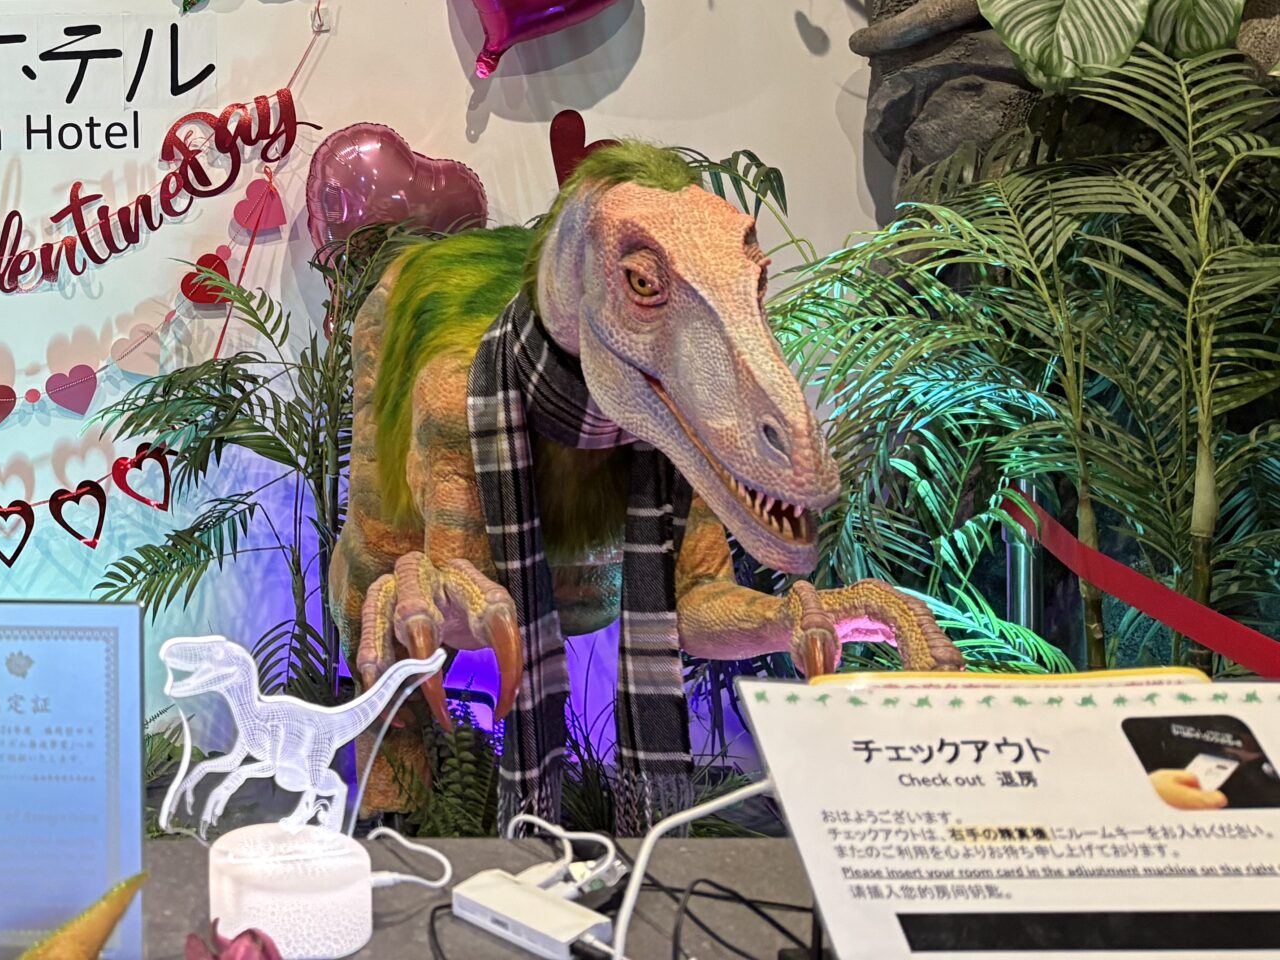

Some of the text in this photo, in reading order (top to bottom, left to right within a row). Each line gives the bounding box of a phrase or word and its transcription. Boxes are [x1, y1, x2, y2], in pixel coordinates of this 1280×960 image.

[25, 110, 140, 150] Hotel
[161, 88, 322, 198] Day
[852, 737, 1051, 764] チェックアウト
[898, 770, 1038, 788] Check out 退房
[821, 810, 962, 825] おはようございます。
[841, 866, 884, 878] Please
[887, 866, 924, 878] insert
[926, 868, 956, 879] your
[958, 868, 994, 878] room
[996, 866, 1024, 878] card
[1026, 866, 1040, 877] in
[1042, 864, 1062, 877] the
[1068, 864, 1138, 878] adjustment
[1143, 863, 1198, 877] machine
[1200, 866, 1220, 877] on
[1221, 863, 1243, 877] the
